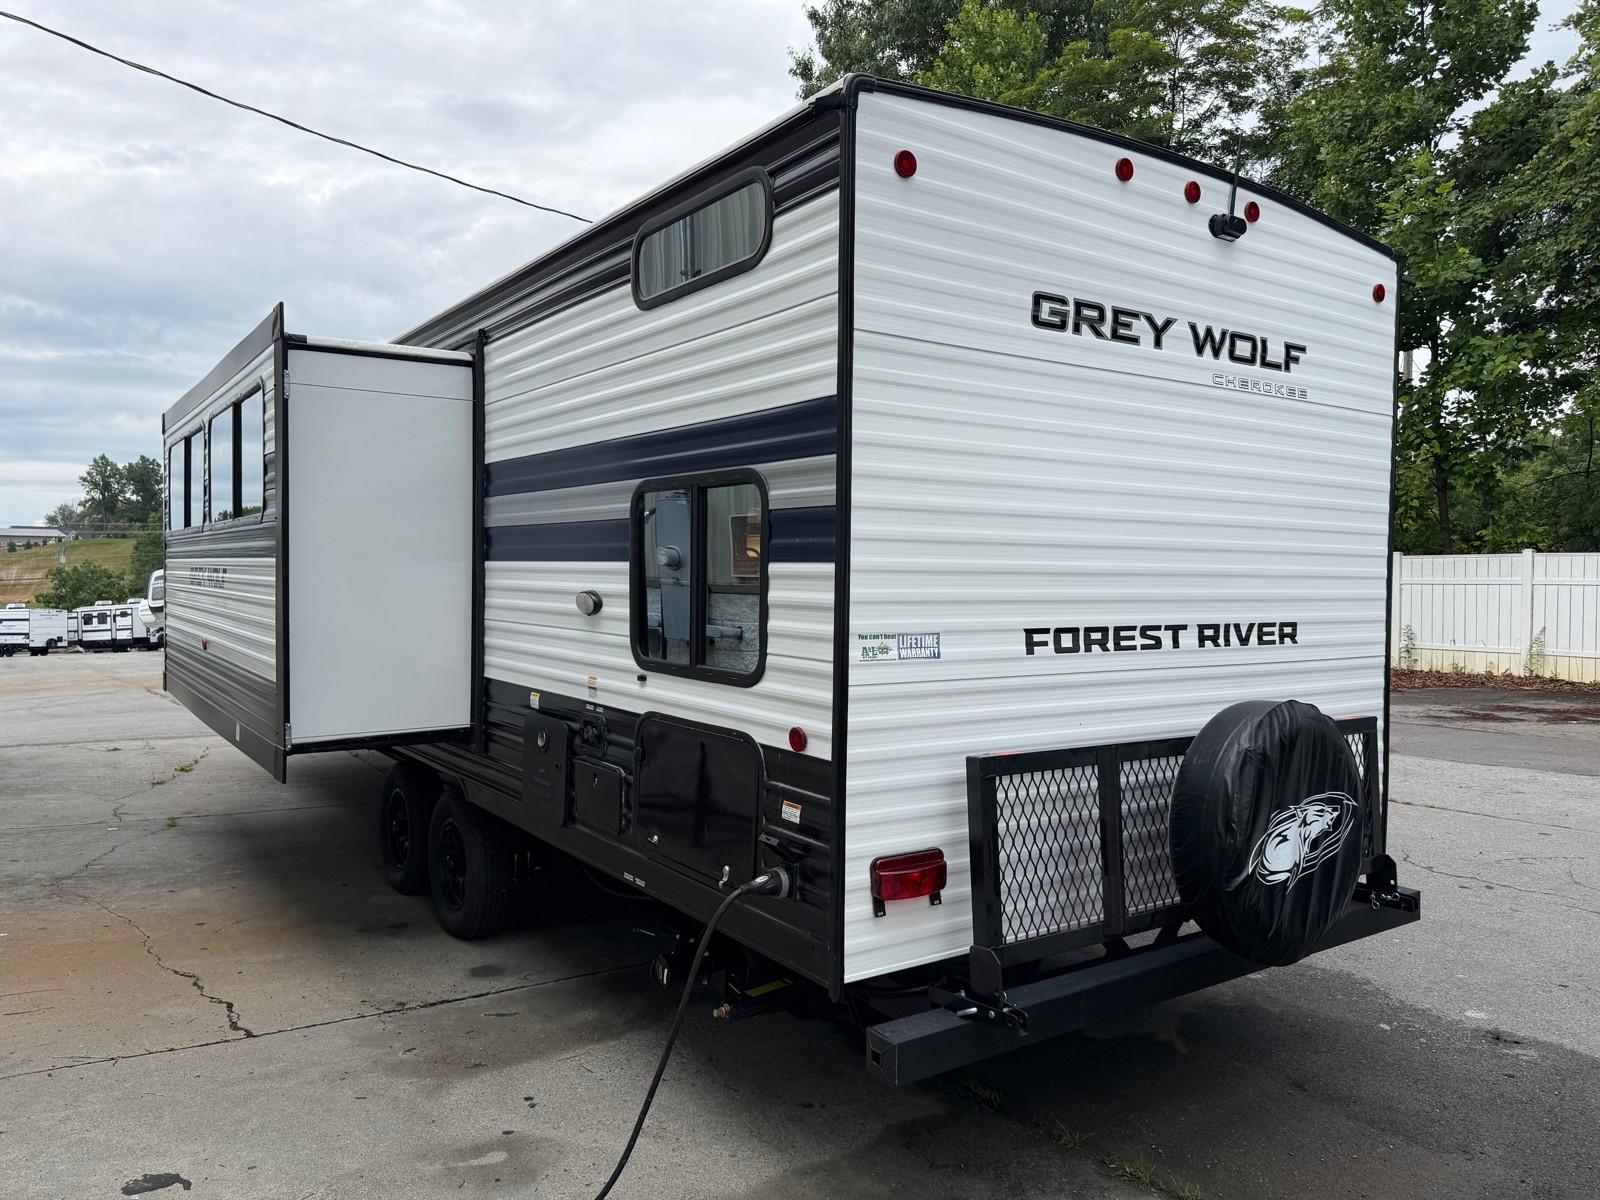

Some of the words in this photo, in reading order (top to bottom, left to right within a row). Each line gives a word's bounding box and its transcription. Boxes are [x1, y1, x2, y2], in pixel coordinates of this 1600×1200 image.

[1031, 290, 1178, 350] GREY
[1187, 321, 1307, 373] WOLF
[1212, 373, 1308, 399] CHEROKEE
[899, 635, 938, 647] LIFETIME
[1023, 624, 1189, 656] FOREST
[1196, 622, 1298, 648] RIVER
[899, 648, 939, 658] WARRANTY
